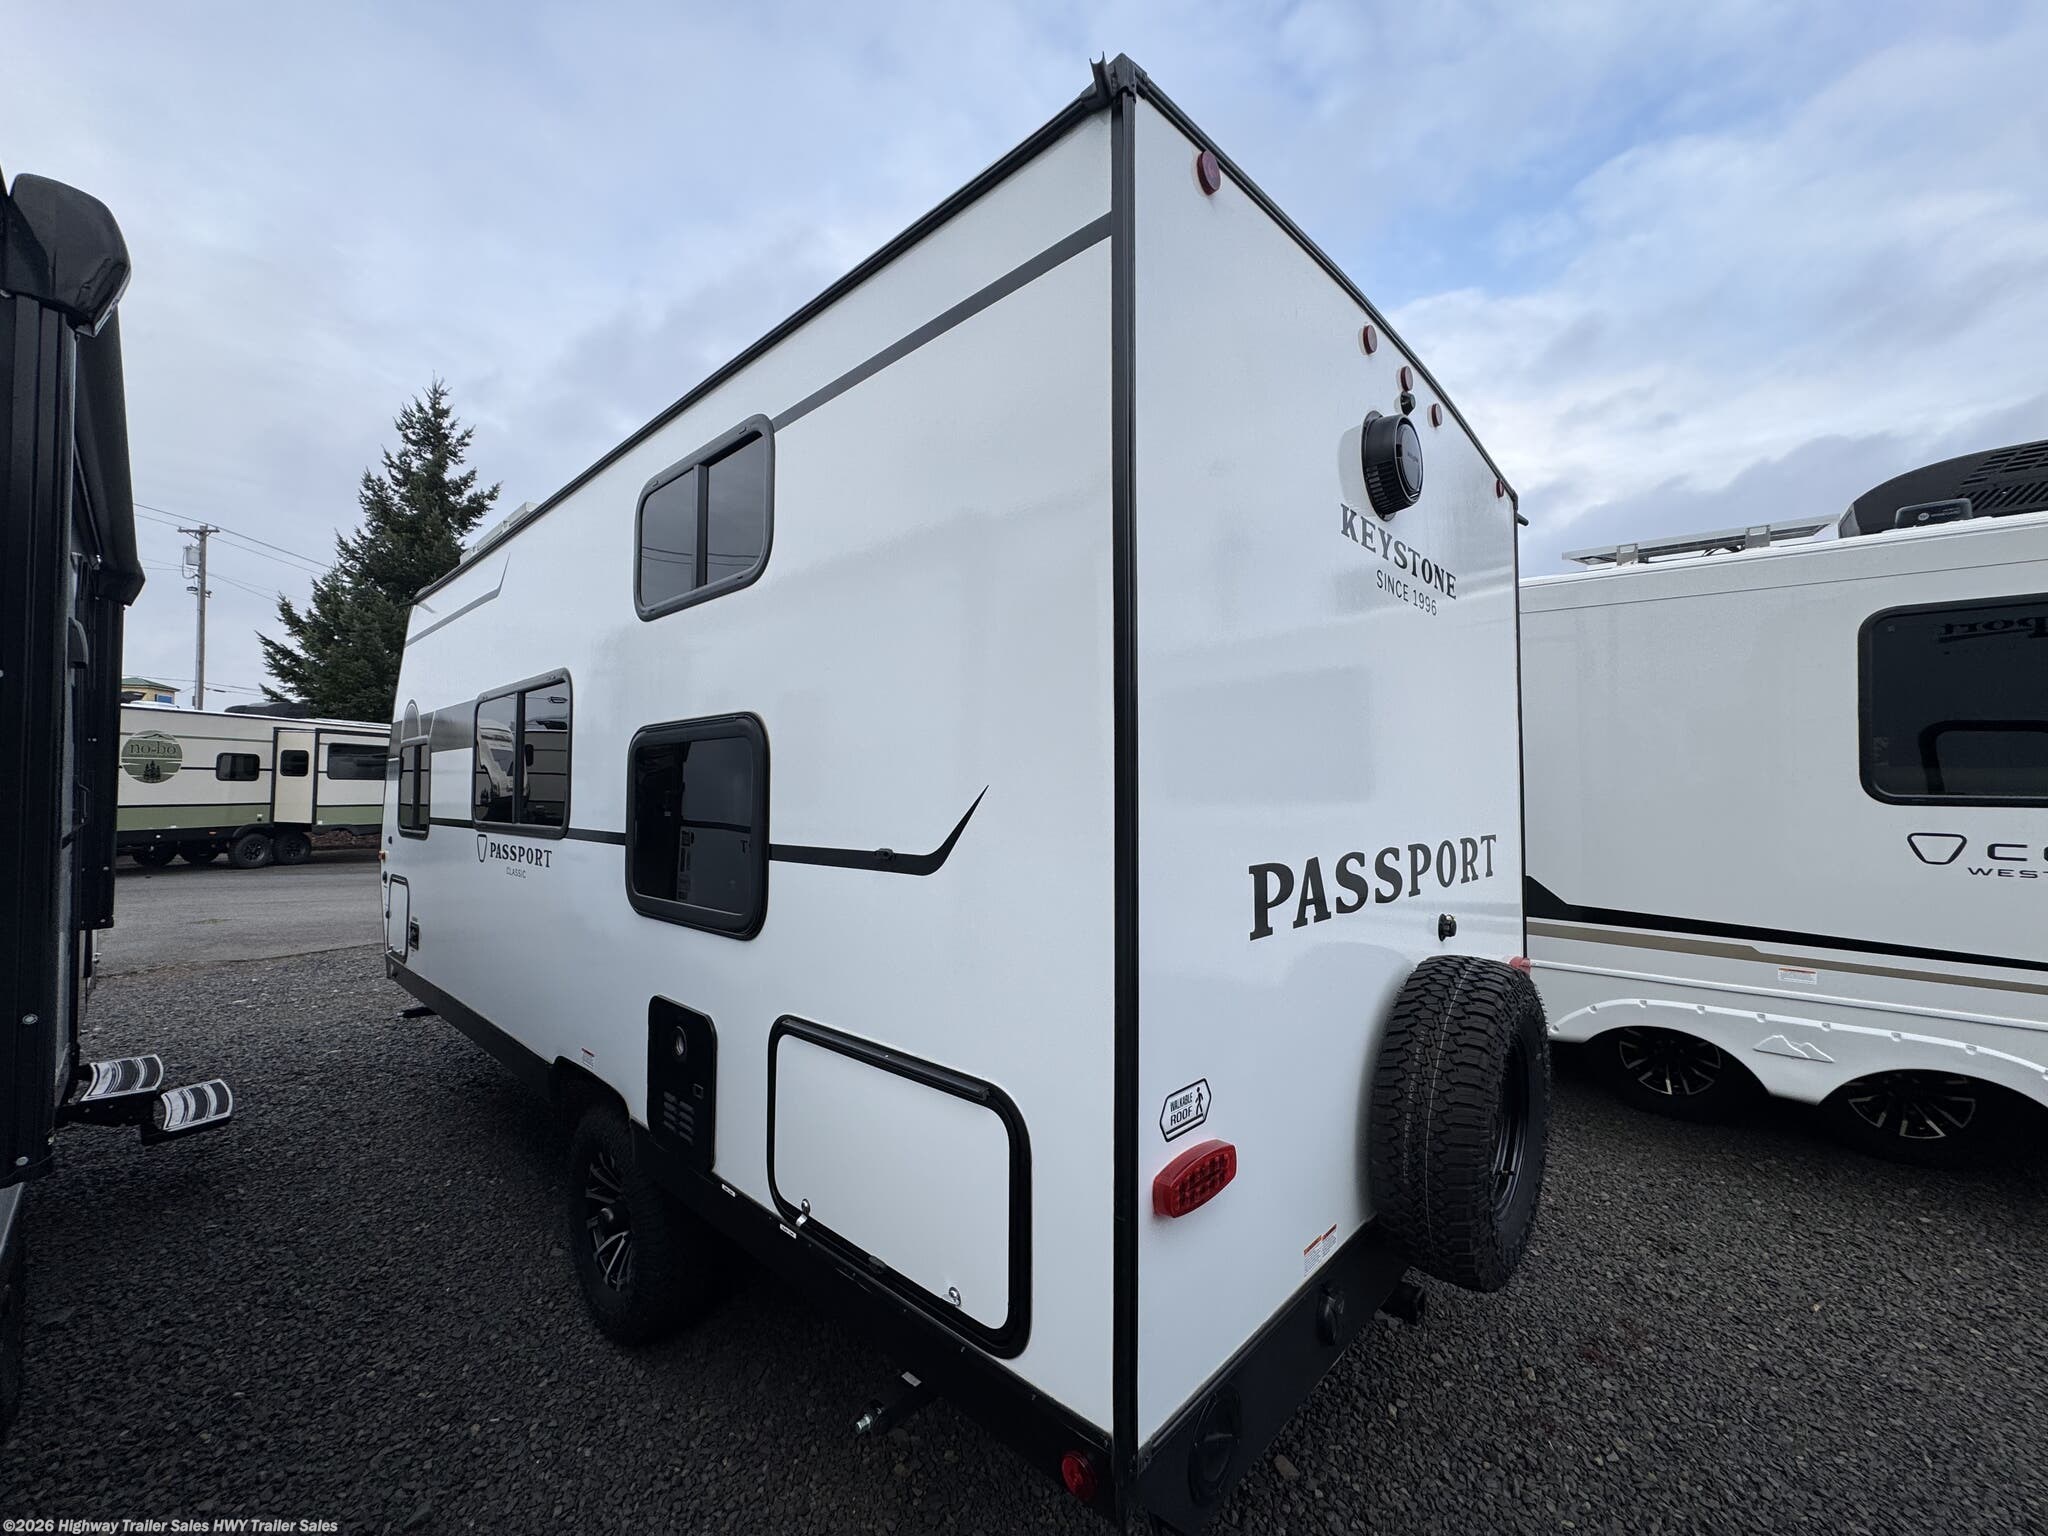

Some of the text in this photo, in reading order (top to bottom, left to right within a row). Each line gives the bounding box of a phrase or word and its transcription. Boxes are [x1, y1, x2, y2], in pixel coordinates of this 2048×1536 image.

[1340, 503, 1457, 600] KEYSTONE
[1376, 569, 1437, 616] SINCE 1996
[130, 741, 177, 754] no-bo
[490, 842, 552, 868] PASSPORT
[1987, 843, 2048, 862] C
[1249, 834, 1497, 941] PASSPORT
[1170, 1106, 1193, 1126] ROOF
